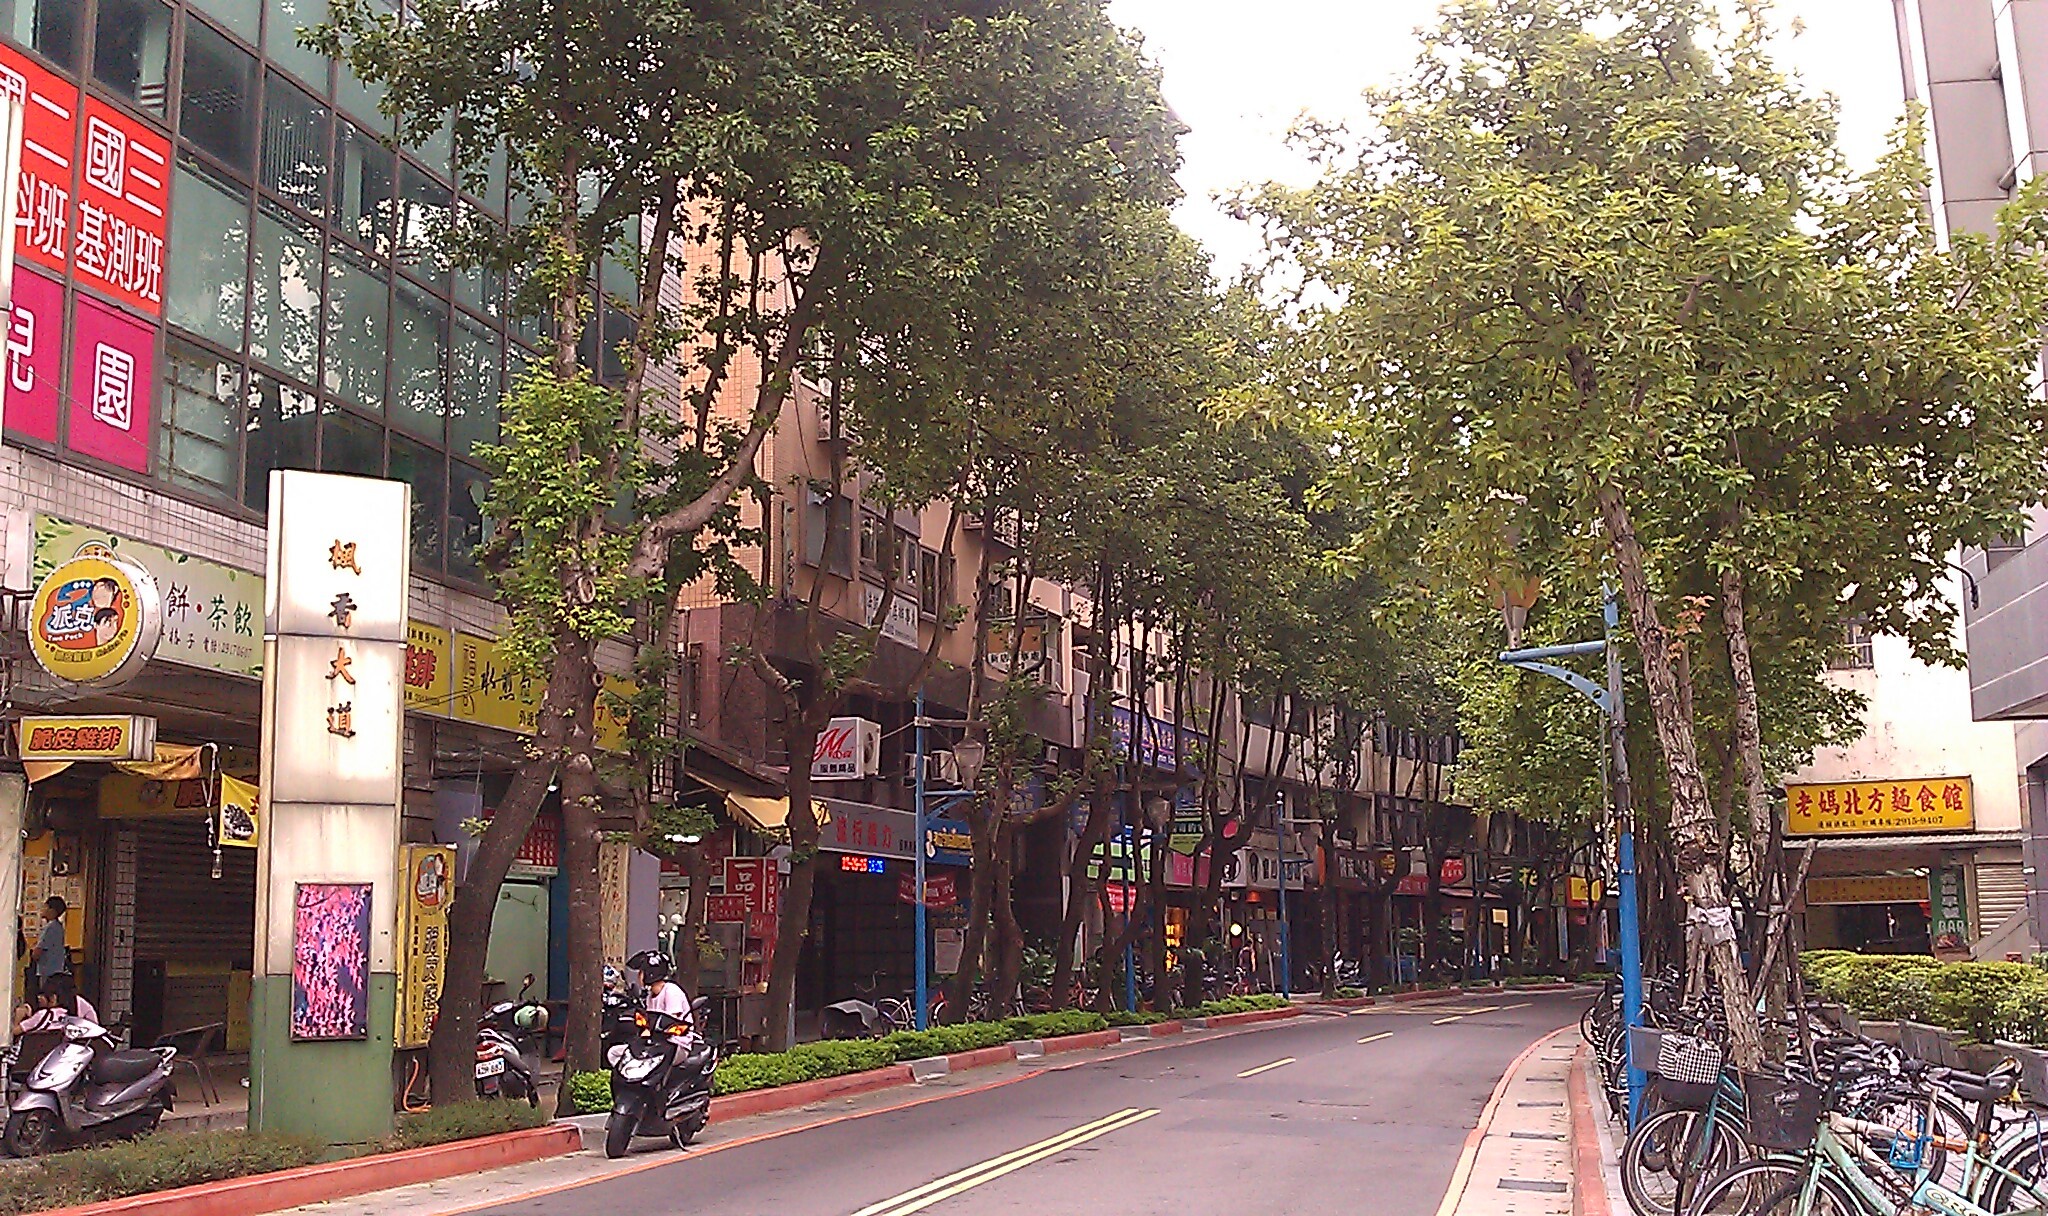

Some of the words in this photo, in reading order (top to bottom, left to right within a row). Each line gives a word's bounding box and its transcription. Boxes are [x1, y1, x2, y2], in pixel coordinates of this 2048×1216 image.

[85, 114, 164, 217] 國三
[74, 199, 164, 303] 基測班
[50, 603, 95, 632] 派克
[327, 538, 362, 739] 楓香大道
[28, 727, 123, 751] 脆皮雞排
